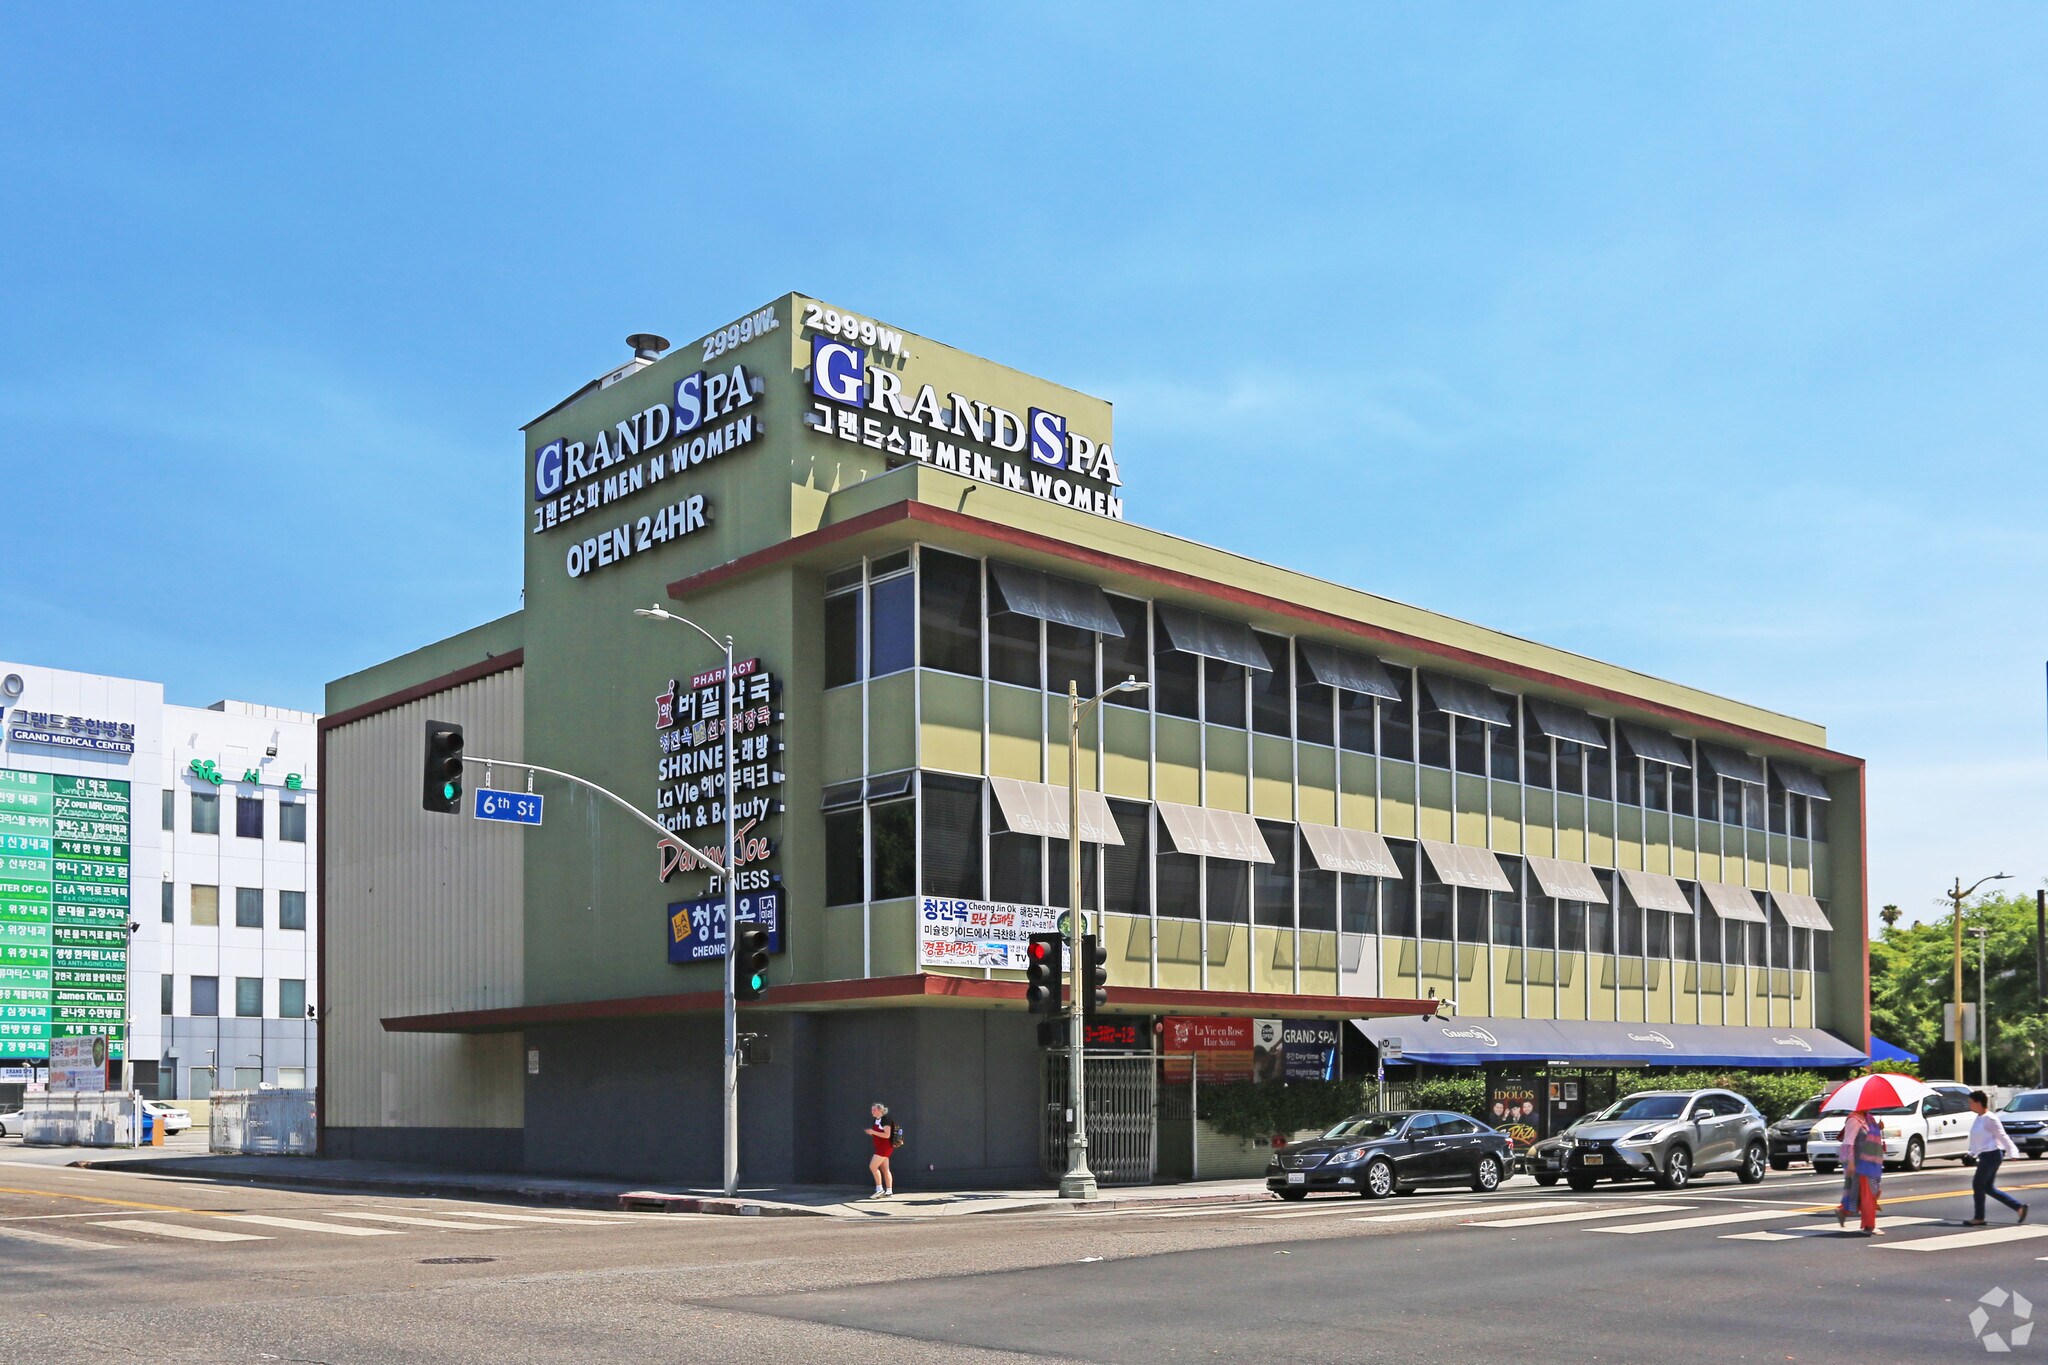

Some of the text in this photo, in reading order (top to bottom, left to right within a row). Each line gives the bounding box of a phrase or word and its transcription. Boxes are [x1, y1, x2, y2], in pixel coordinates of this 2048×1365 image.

[812, 402, 1124, 520] 그랜드스파 MEN N WOMEN
[533, 414, 753, 535] 그랜드스파 MEN N WOMEN
[566, 494, 706, 579] OPEN 24HR
[14, 730, 132, 752] GRAND MEDICAL CENTER
[190, 758, 224, 785] SMG
[658, 744, 723, 782] SHRINE
[71, 800, 88, 809] OPEN
[483, 795, 536, 817] 6th St
[657, 788, 674, 809] La
[674, 782, 699, 805] Vie
[695, 805, 708, 827] &
[711, 796, 770, 824] Bauty
[55, 861, 79, 875] 하나
[21, 885, 49, 894] OF CA
[709, 869, 770, 894] FINESS
[923, 899, 969, 922] 청진옥
[968, 902, 995, 914] Cheong
[995, 903, 1006, 912] Jin
[1007, 904, 1017, 913] Ok
[970, 913, 988, 926] 모닝
[992, 928, 1017, 940] 극찬한
[924, 940, 978, 957] 경품대잔치
[1015, 953, 1027, 963] TV
[57, 991, 86, 1001] James
[1194, 1025, 1204, 1036] La
[1204, 1025, 1217, 1036] Vie
[1227, 1026, 1245, 1036] Rose
[1283, 1029, 1317, 1044] GRAND
[1203, 1037, 1236, 1047] Hair Salon
